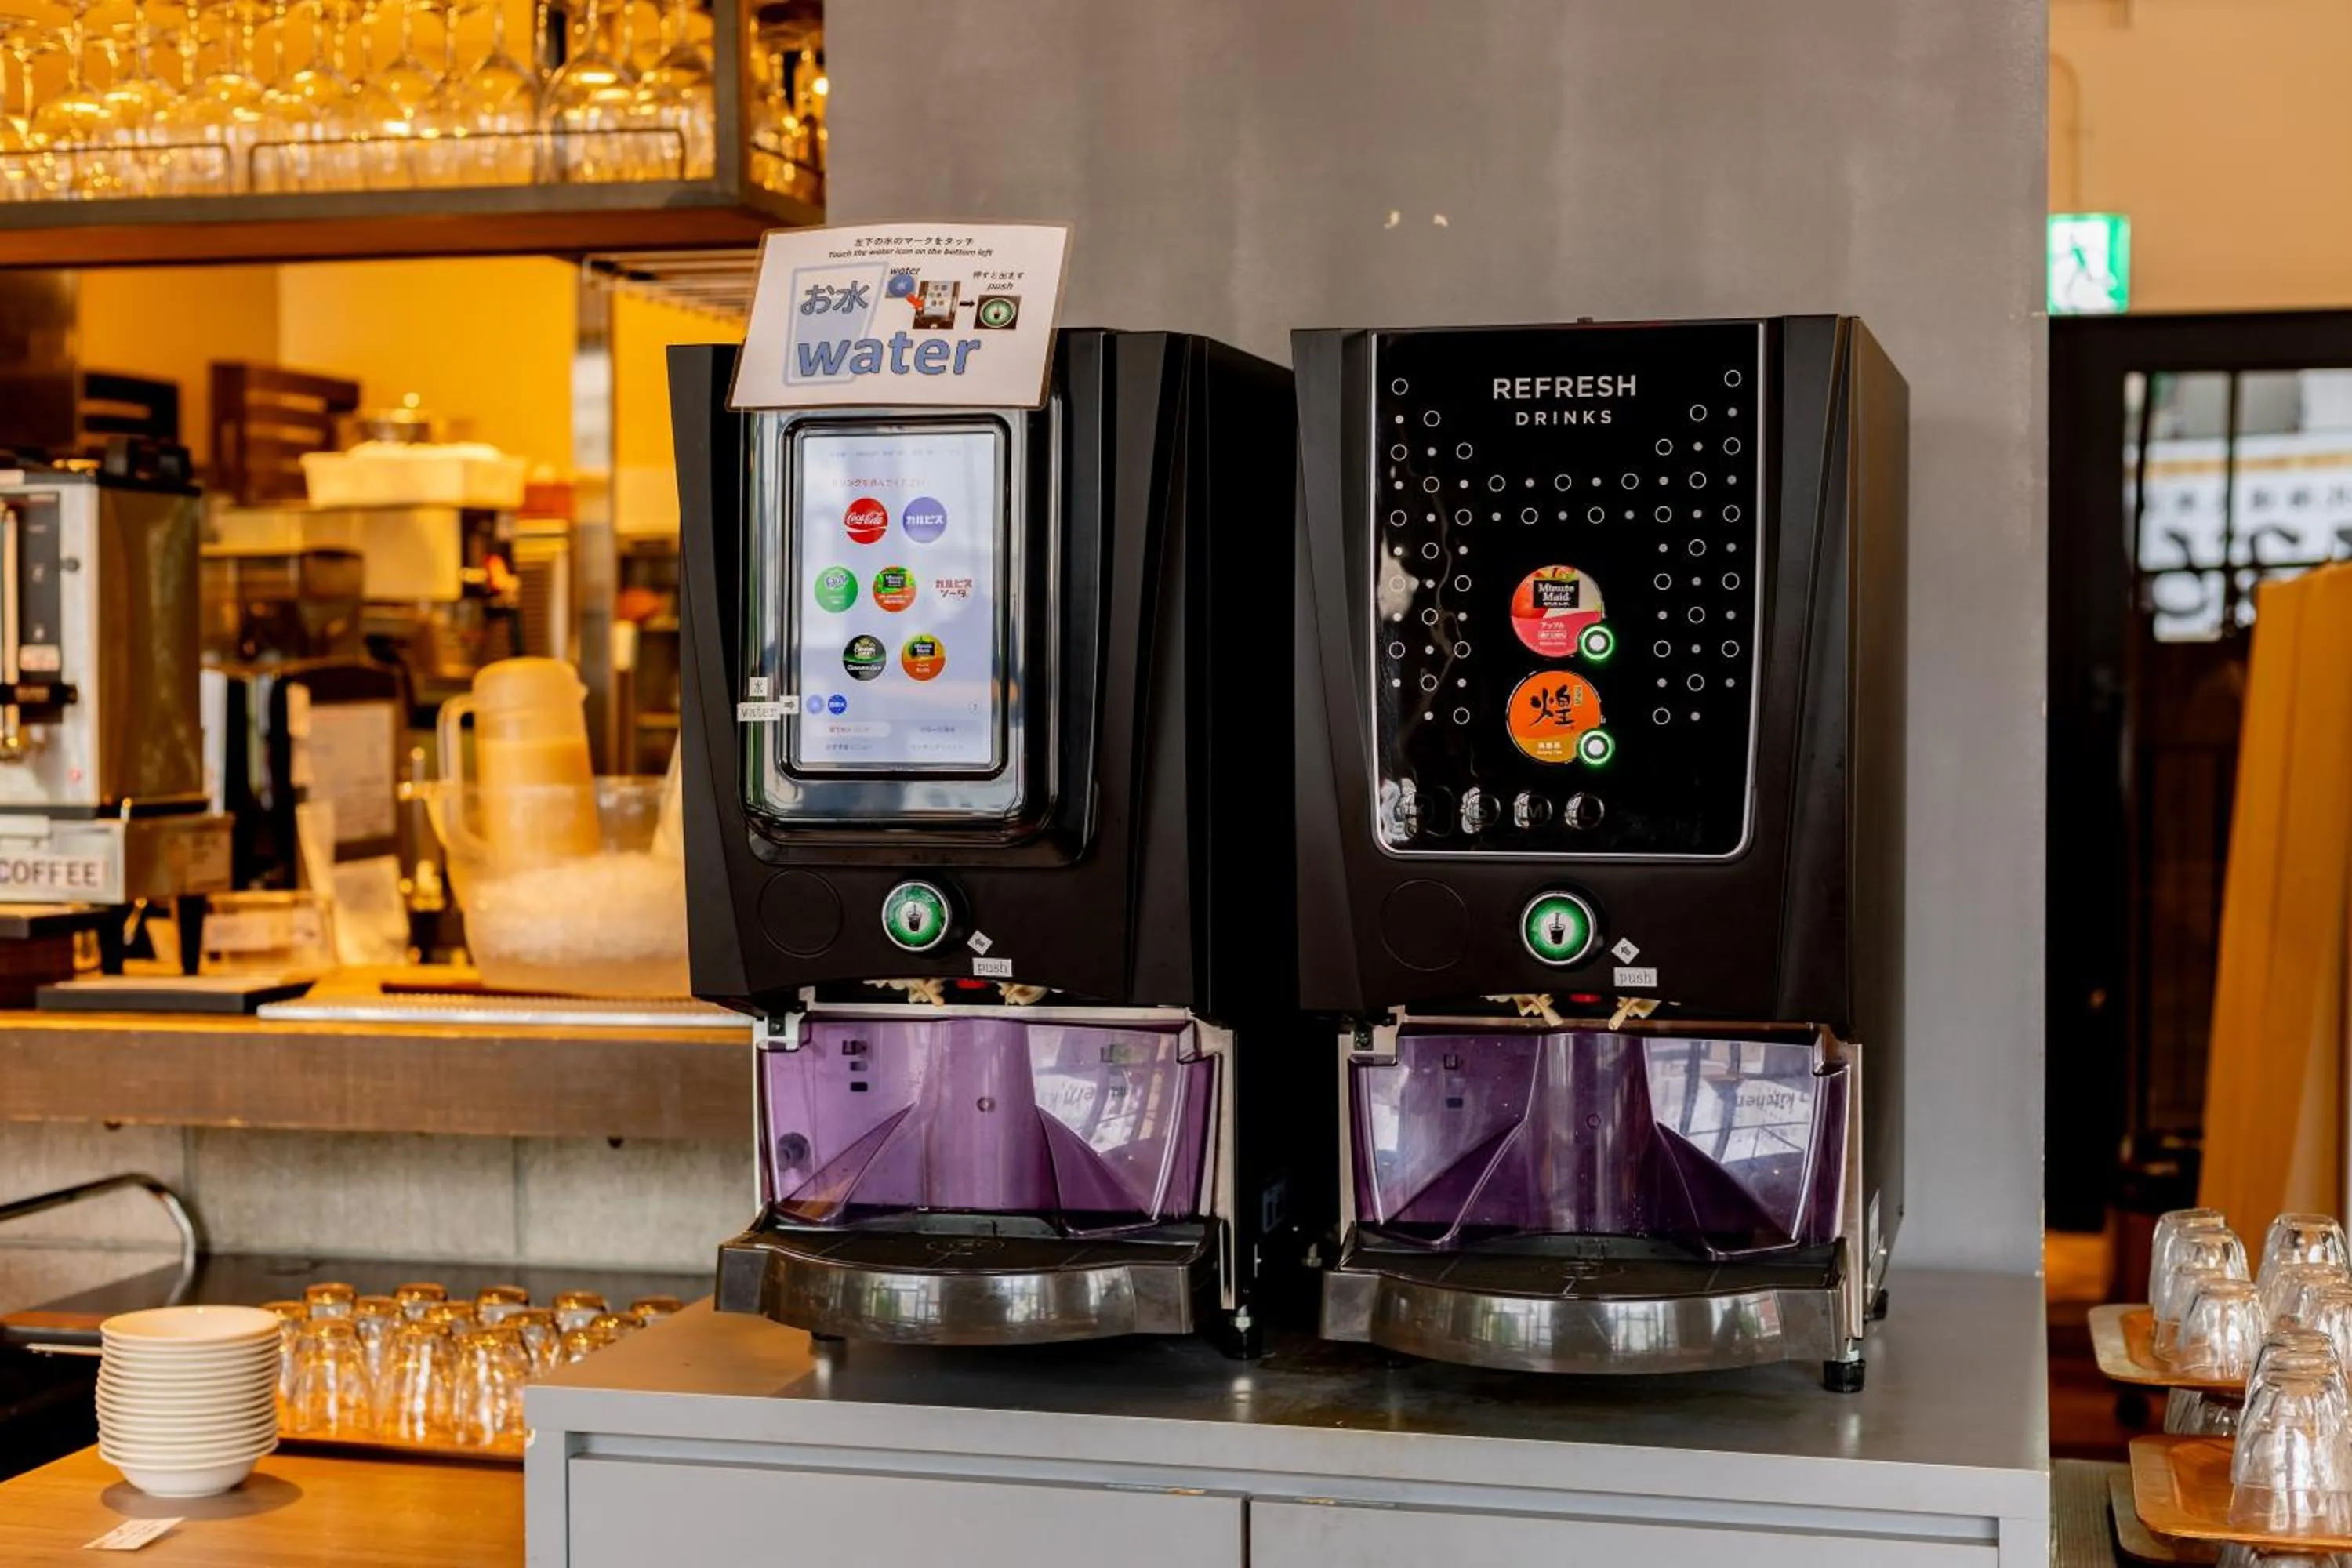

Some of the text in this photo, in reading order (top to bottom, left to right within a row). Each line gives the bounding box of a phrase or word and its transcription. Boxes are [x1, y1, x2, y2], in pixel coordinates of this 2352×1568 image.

[890, 267, 920, 275] water
[986, 282, 1014, 291] push
[800, 280, 870, 315] お水
[797, 331, 981, 377] water
[1493, 374, 1637, 400] REFRESH
[1515, 410, 1612, 426] DRINKS
[906, 514, 944, 525] カルピス
[935, 579, 972, 588] カルピス
[1537, 583, 1575, 593] Minute
[1542, 592, 1571, 601] Maid
[1530, 684, 1575, 726] 煌
[978, 960, 1008, 975] push
[1619, 970, 1652, 985] push
